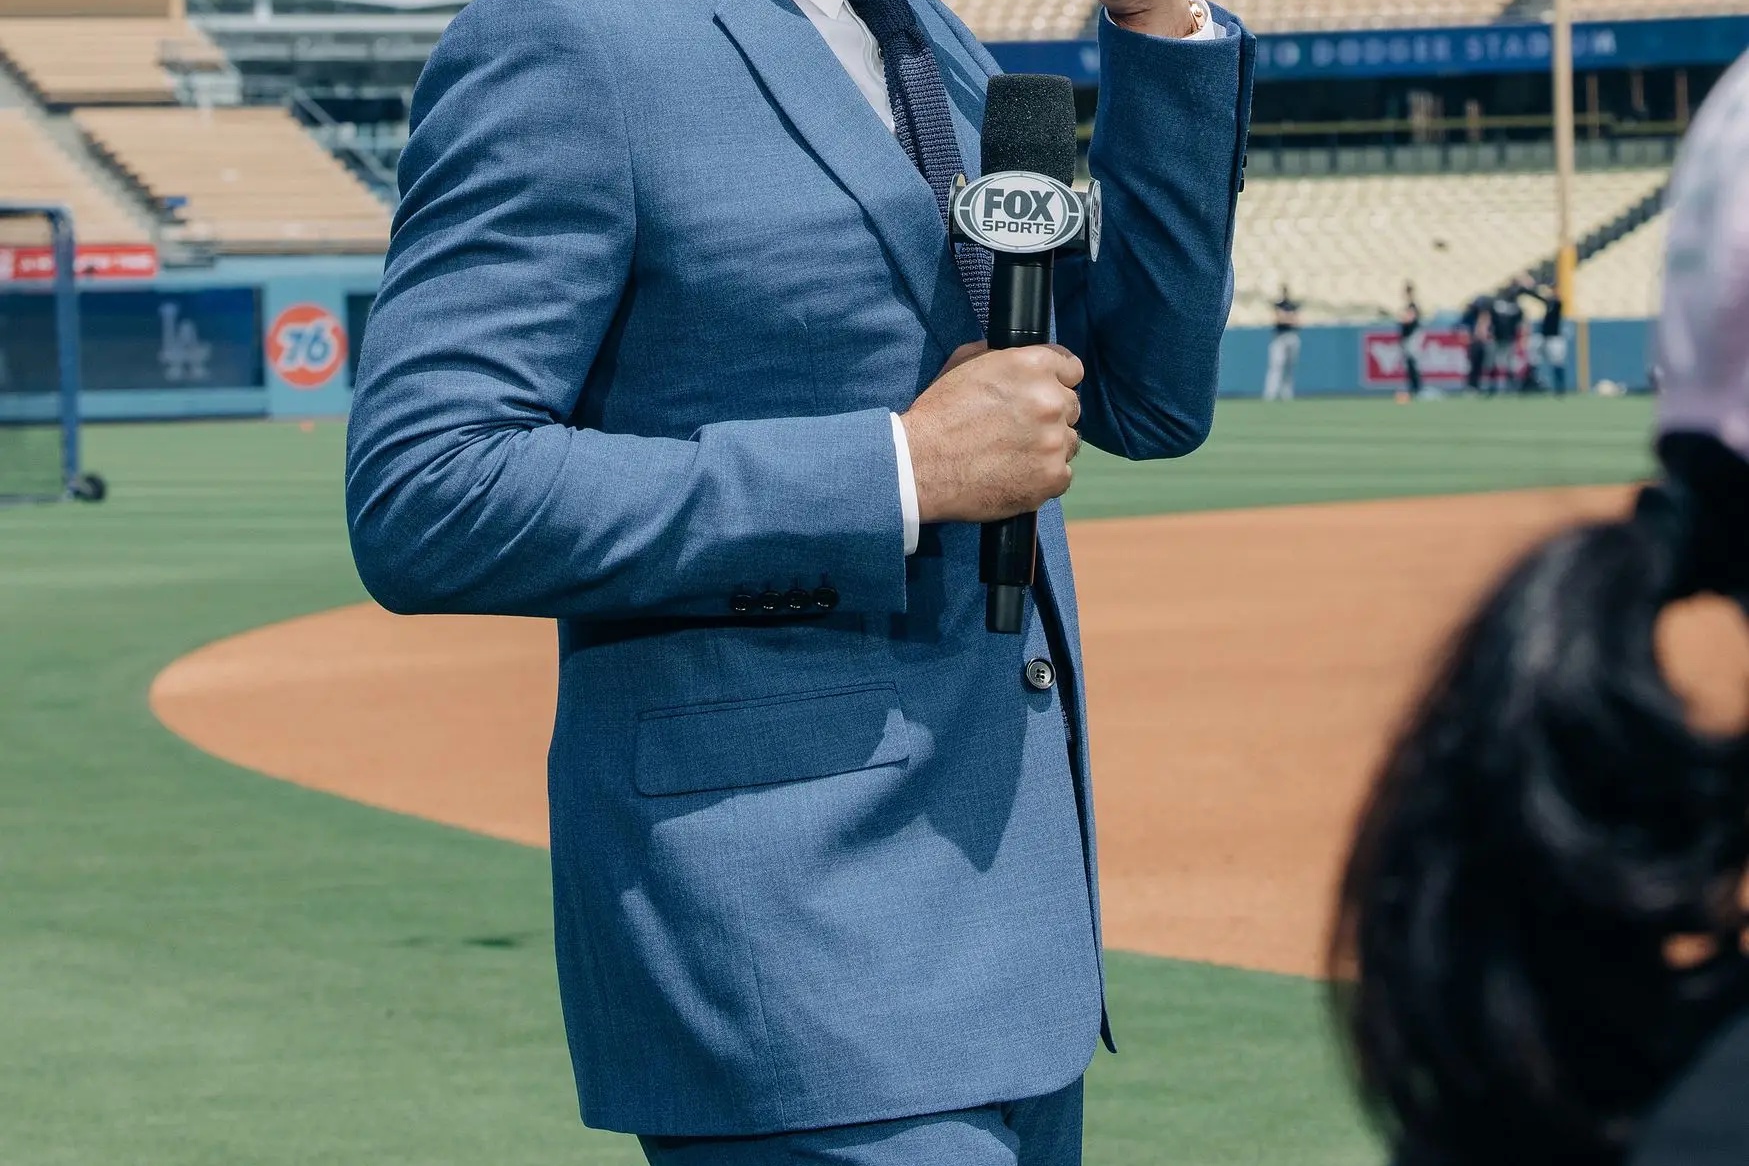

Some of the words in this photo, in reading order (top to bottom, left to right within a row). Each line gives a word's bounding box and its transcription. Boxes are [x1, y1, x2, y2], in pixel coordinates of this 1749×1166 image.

[1463, 29, 1616, 61] STADUM
[984, 188, 1055, 222] FOX
[982, 220, 1055, 236] SPORTS
[280, 320, 335, 368] 76
